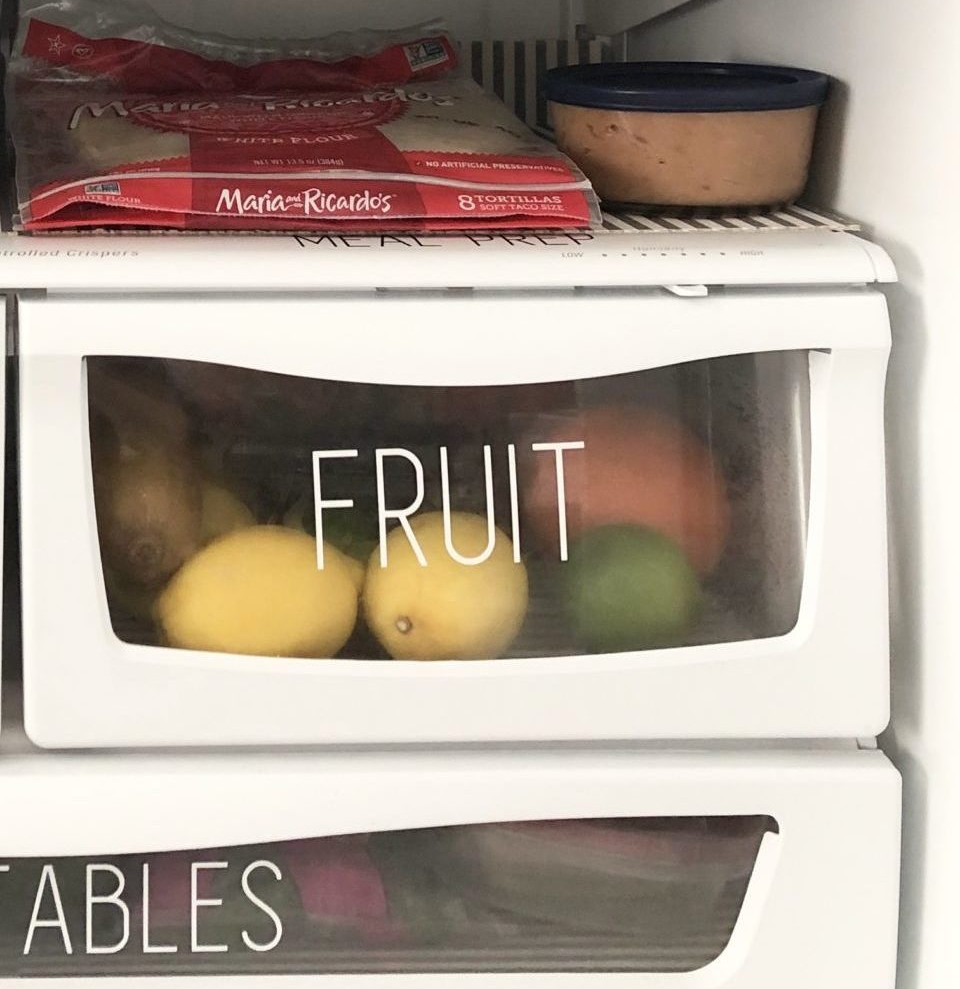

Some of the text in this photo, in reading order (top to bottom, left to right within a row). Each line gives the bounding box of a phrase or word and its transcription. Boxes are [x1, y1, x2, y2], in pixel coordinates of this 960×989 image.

[290, 133, 359, 145] FLOUR
[441, 161, 491, 170] ARTIFICIAL
[493, 163, 564, 172] PRESERVATIVES
[106, 196, 141, 204] FLOUR
[215, 188, 286, 214] Maria
[301, 188, 393, 215] Ricardo's
[458, 194, 562, 210] 8 TORTILLAS
[480, 203, 508, 211] SOFT
[293, 233, 595, 247] MEAL PREP
[66, 249, 139, 259] Crispers
[312, 441, 585, 571] FRUIT
